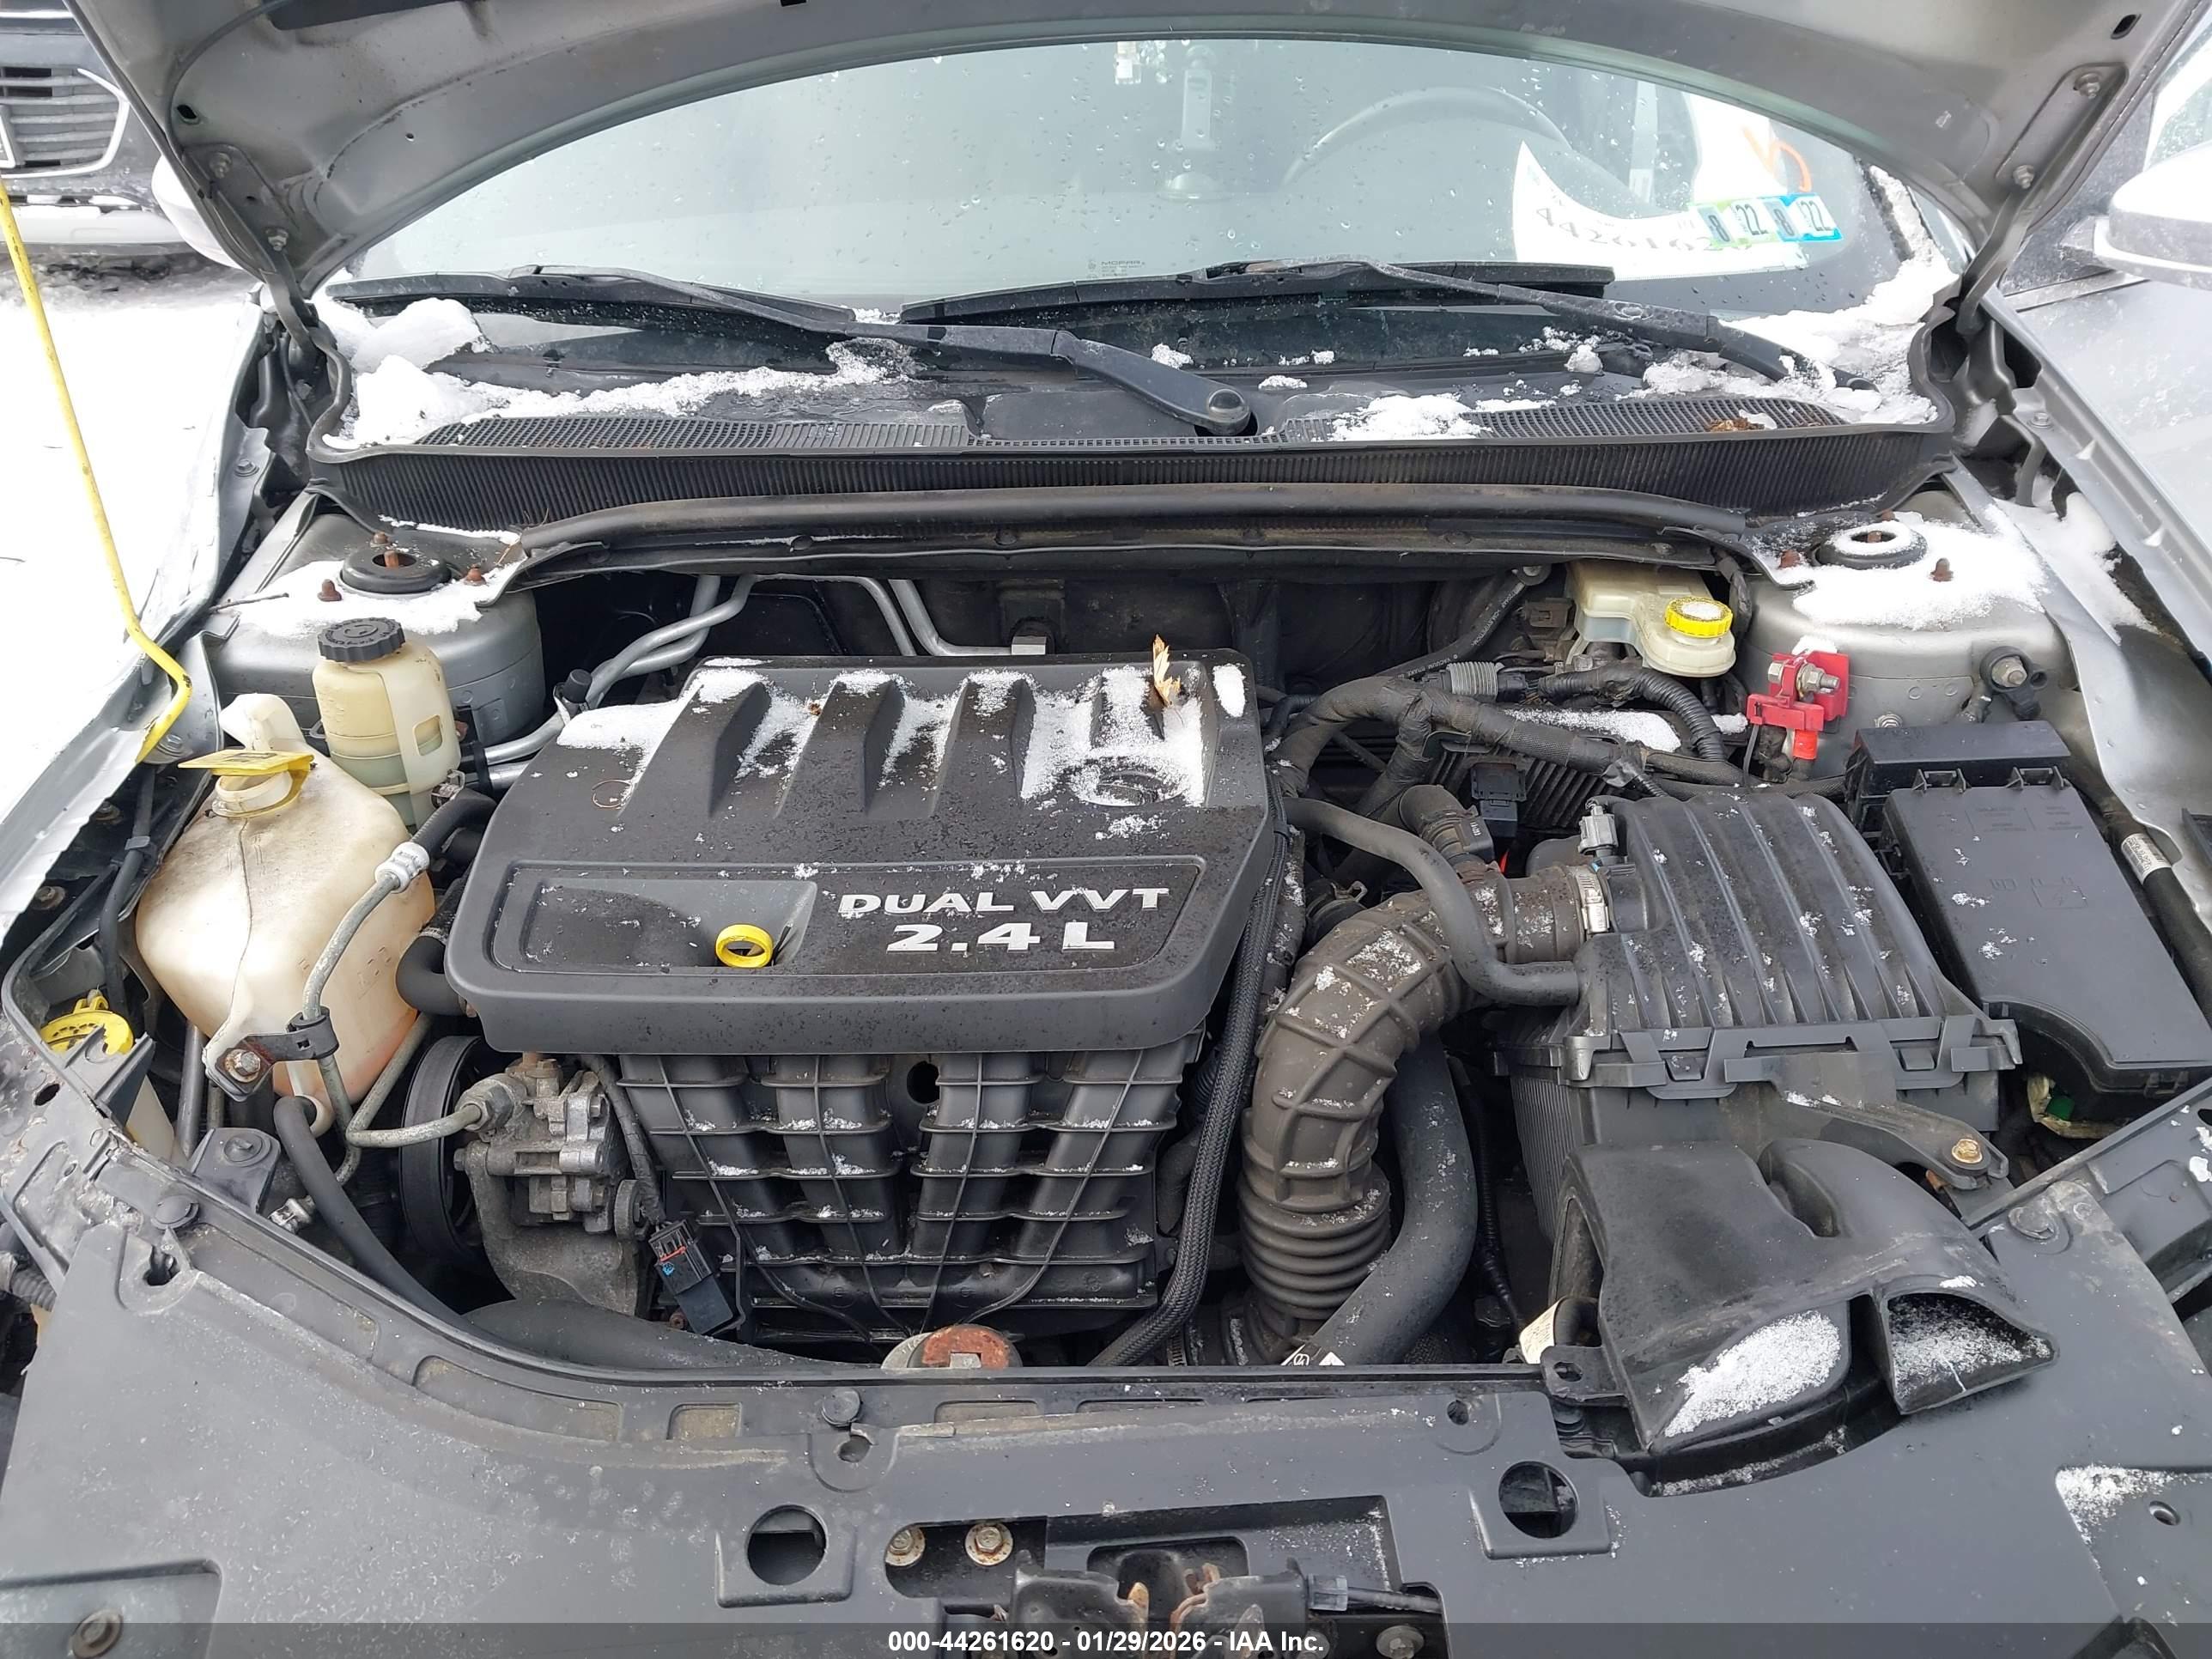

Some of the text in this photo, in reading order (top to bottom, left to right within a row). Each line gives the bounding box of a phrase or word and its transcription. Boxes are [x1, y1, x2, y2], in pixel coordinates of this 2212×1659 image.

[1708, 204, 1769, 242] 8 22
[1773, 200, 1832, 236] 8 22
[838, 887, 1170, 915] DUAL VVT
[886, 921, 1115, 954] 2.4 L
